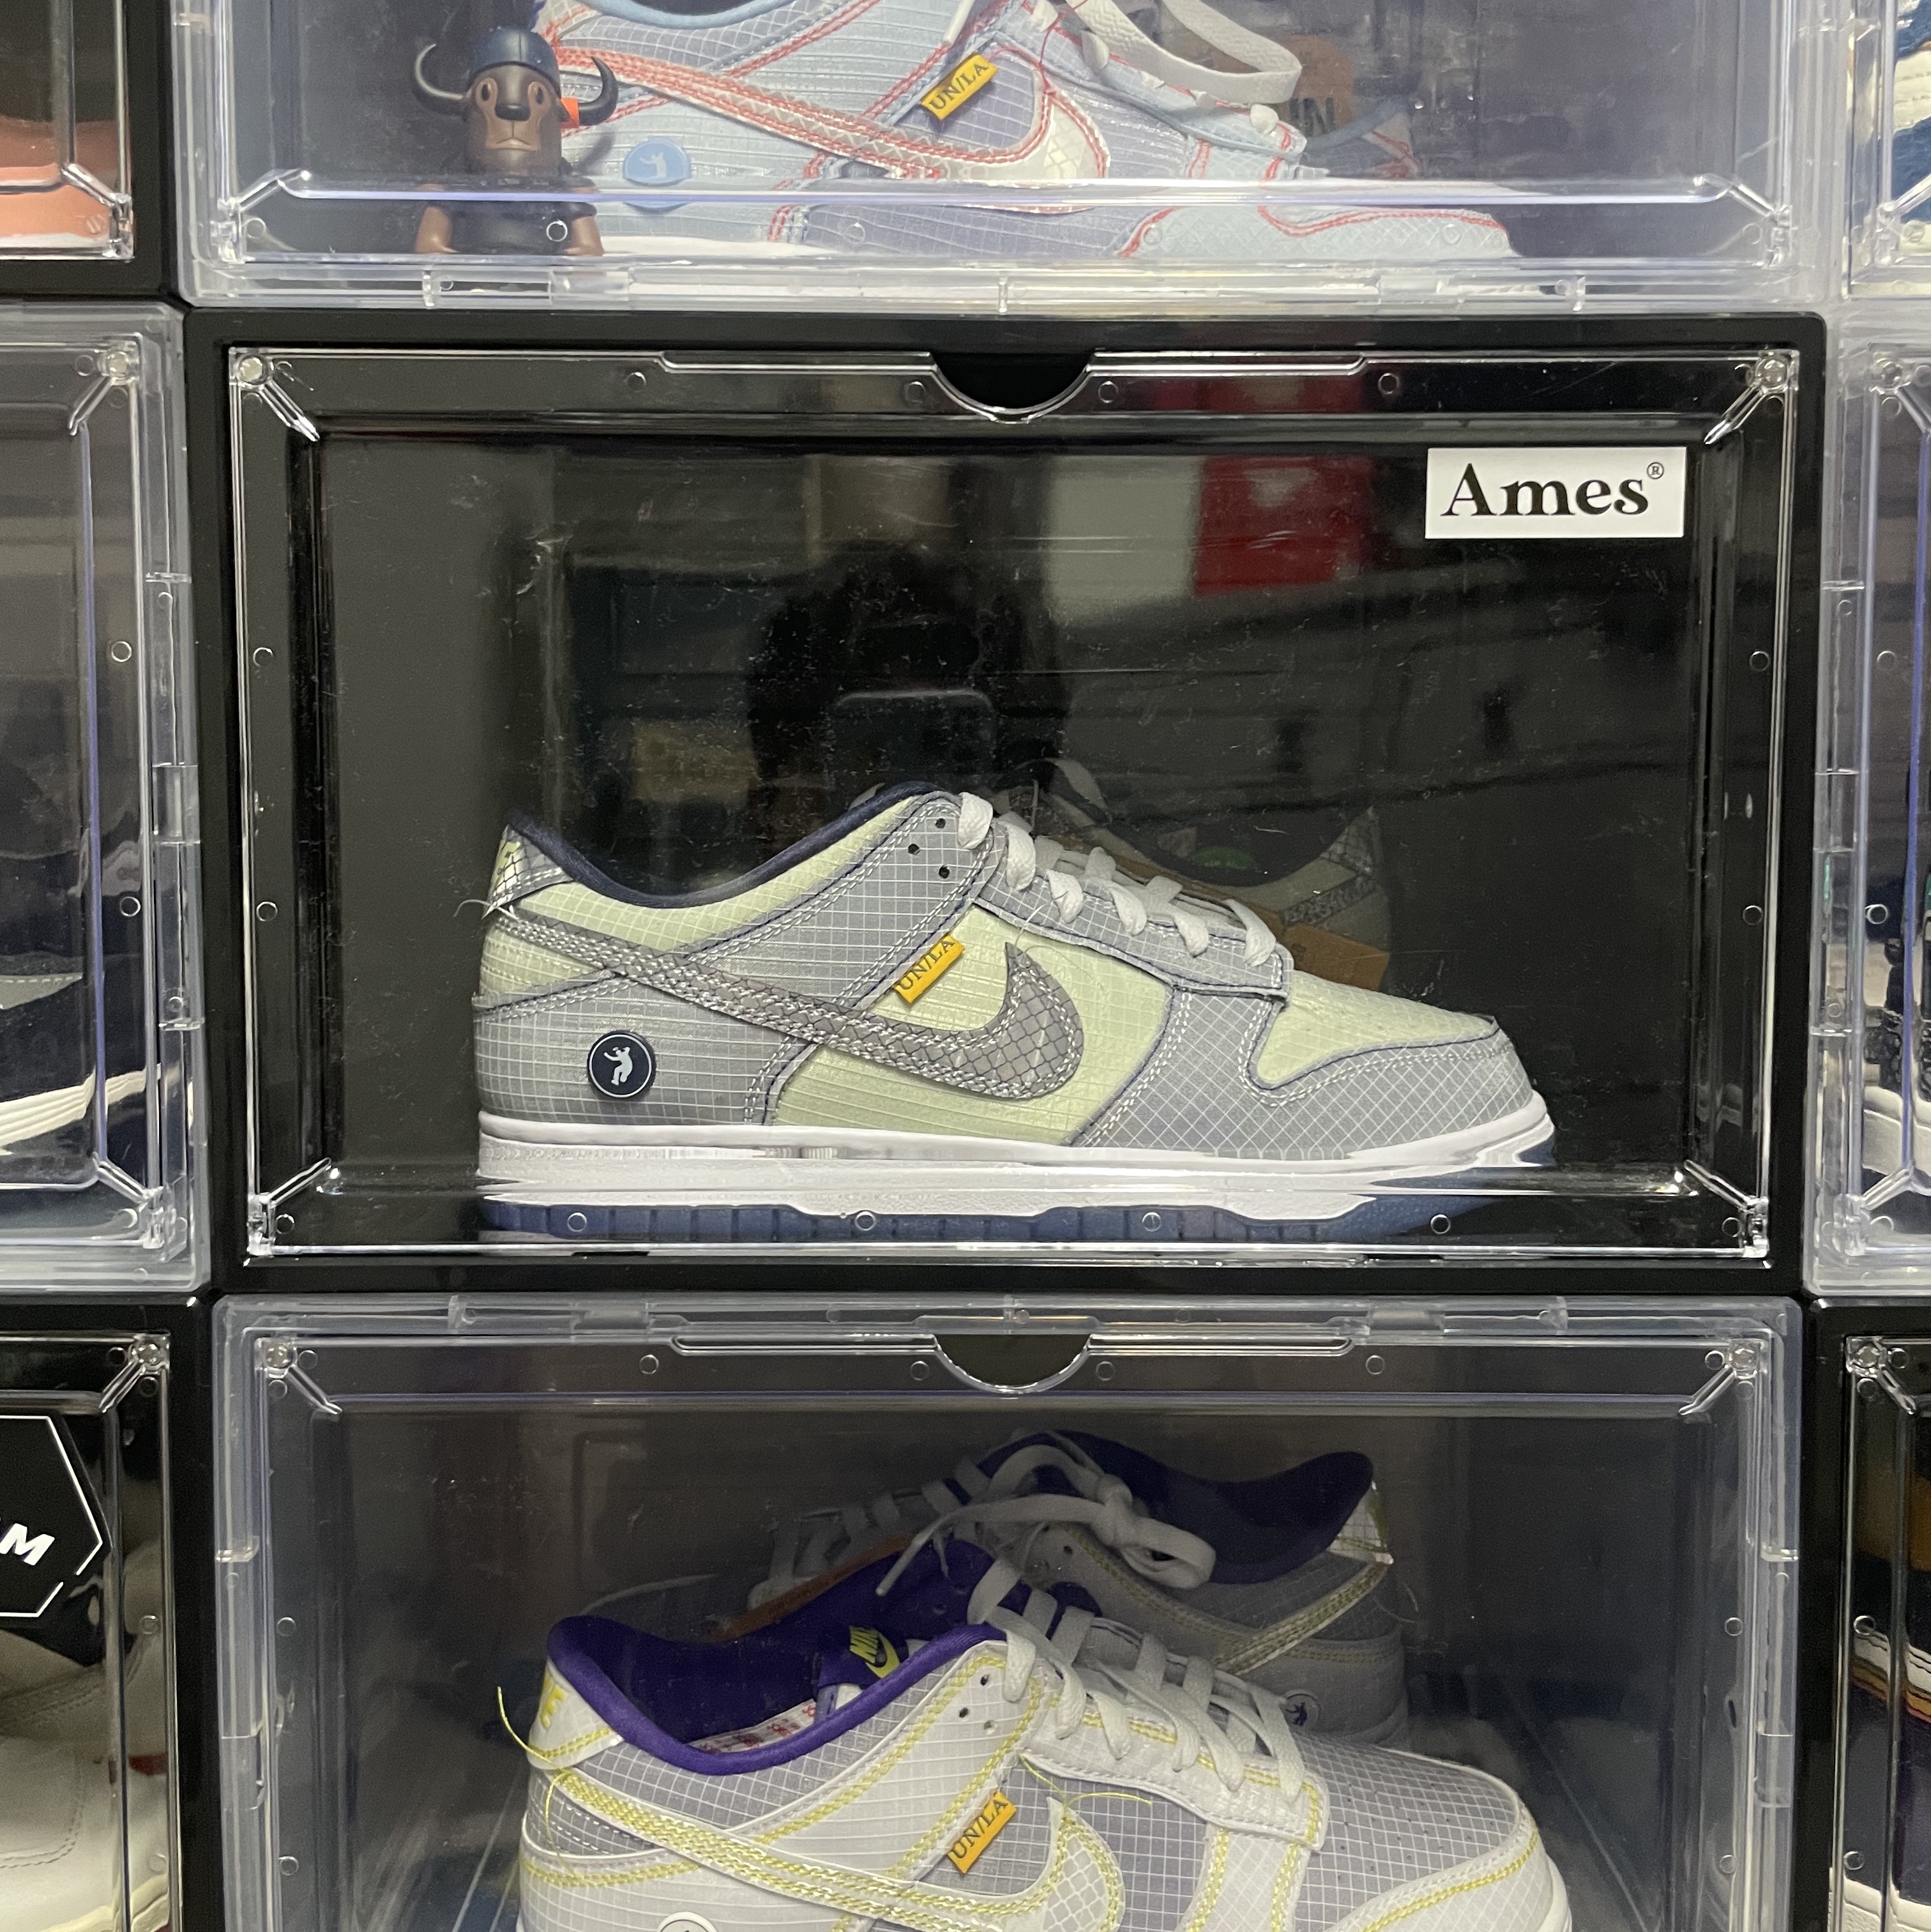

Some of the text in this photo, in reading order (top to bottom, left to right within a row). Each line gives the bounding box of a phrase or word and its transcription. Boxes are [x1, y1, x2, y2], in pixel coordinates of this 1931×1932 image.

[928, 64, 989, 109] UN/LA
[897, 940, 956, 990] UN/LA
[951, 1799, 1009, 1859] UN/LA
